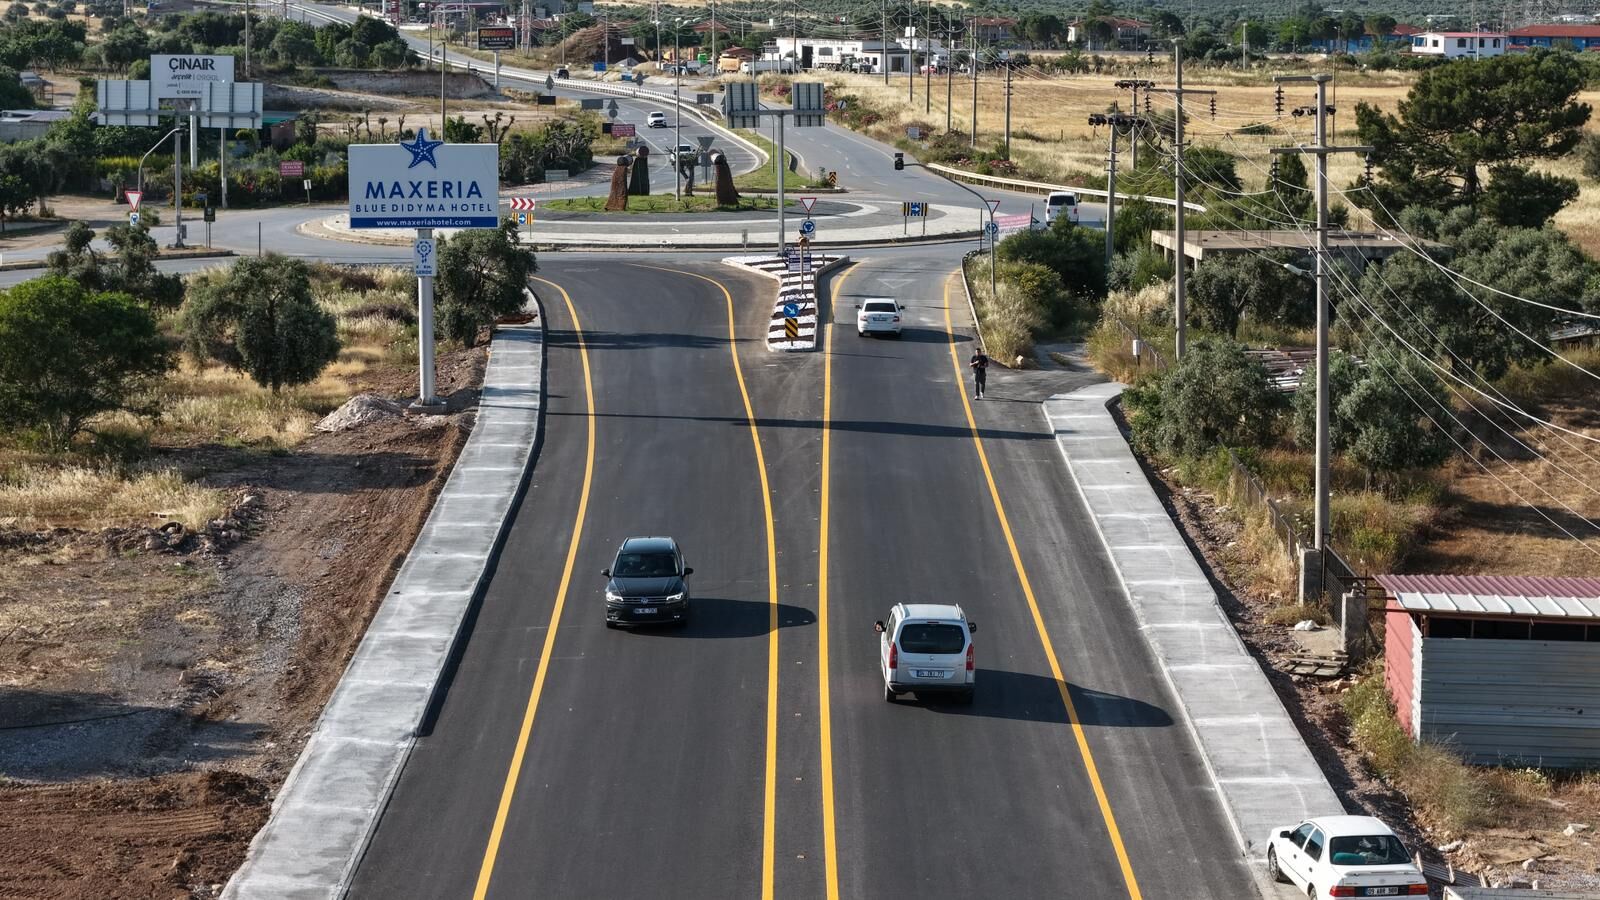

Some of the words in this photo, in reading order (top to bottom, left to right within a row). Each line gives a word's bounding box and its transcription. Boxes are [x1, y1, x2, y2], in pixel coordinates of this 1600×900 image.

[365, 181, 482, 198] MAXERIA
[355, 204, 386, 212] BLUE
[391, 204, 445, 212] DIDYMA
[451, 204, 492, 212] HOTEL
[376, 218, 471, 226] www.maxeriahotel.com
